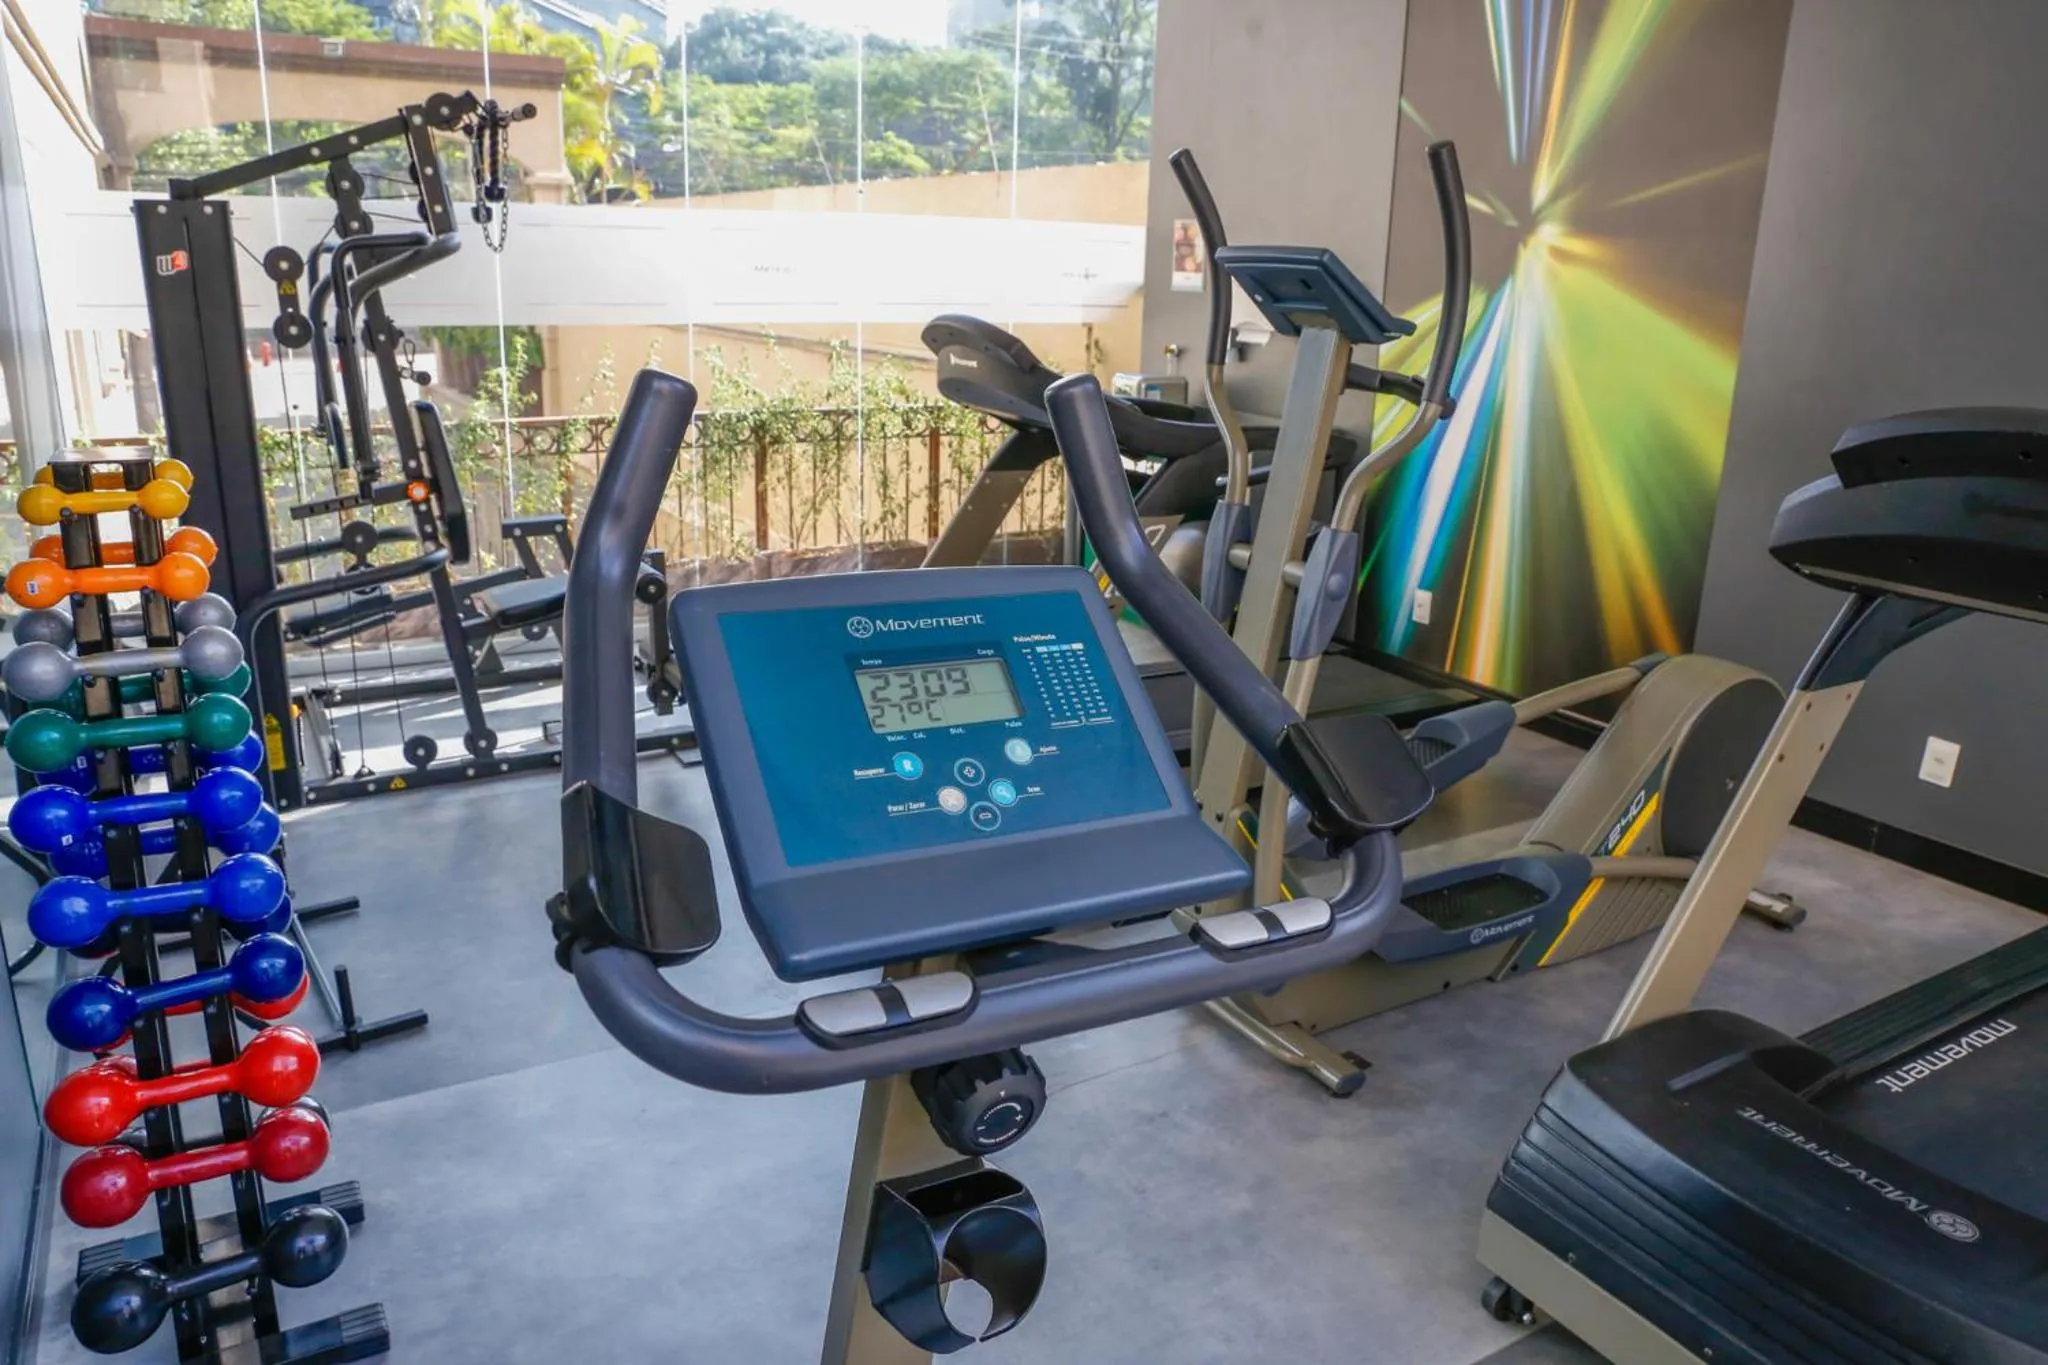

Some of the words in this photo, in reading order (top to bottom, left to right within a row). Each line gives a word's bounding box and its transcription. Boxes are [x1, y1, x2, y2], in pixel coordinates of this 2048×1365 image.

[876, 613, 984, 632] Movement
[1875, 1018, 2018, 1093] movement
[1736, 1106, 1929, 1212] Movement
